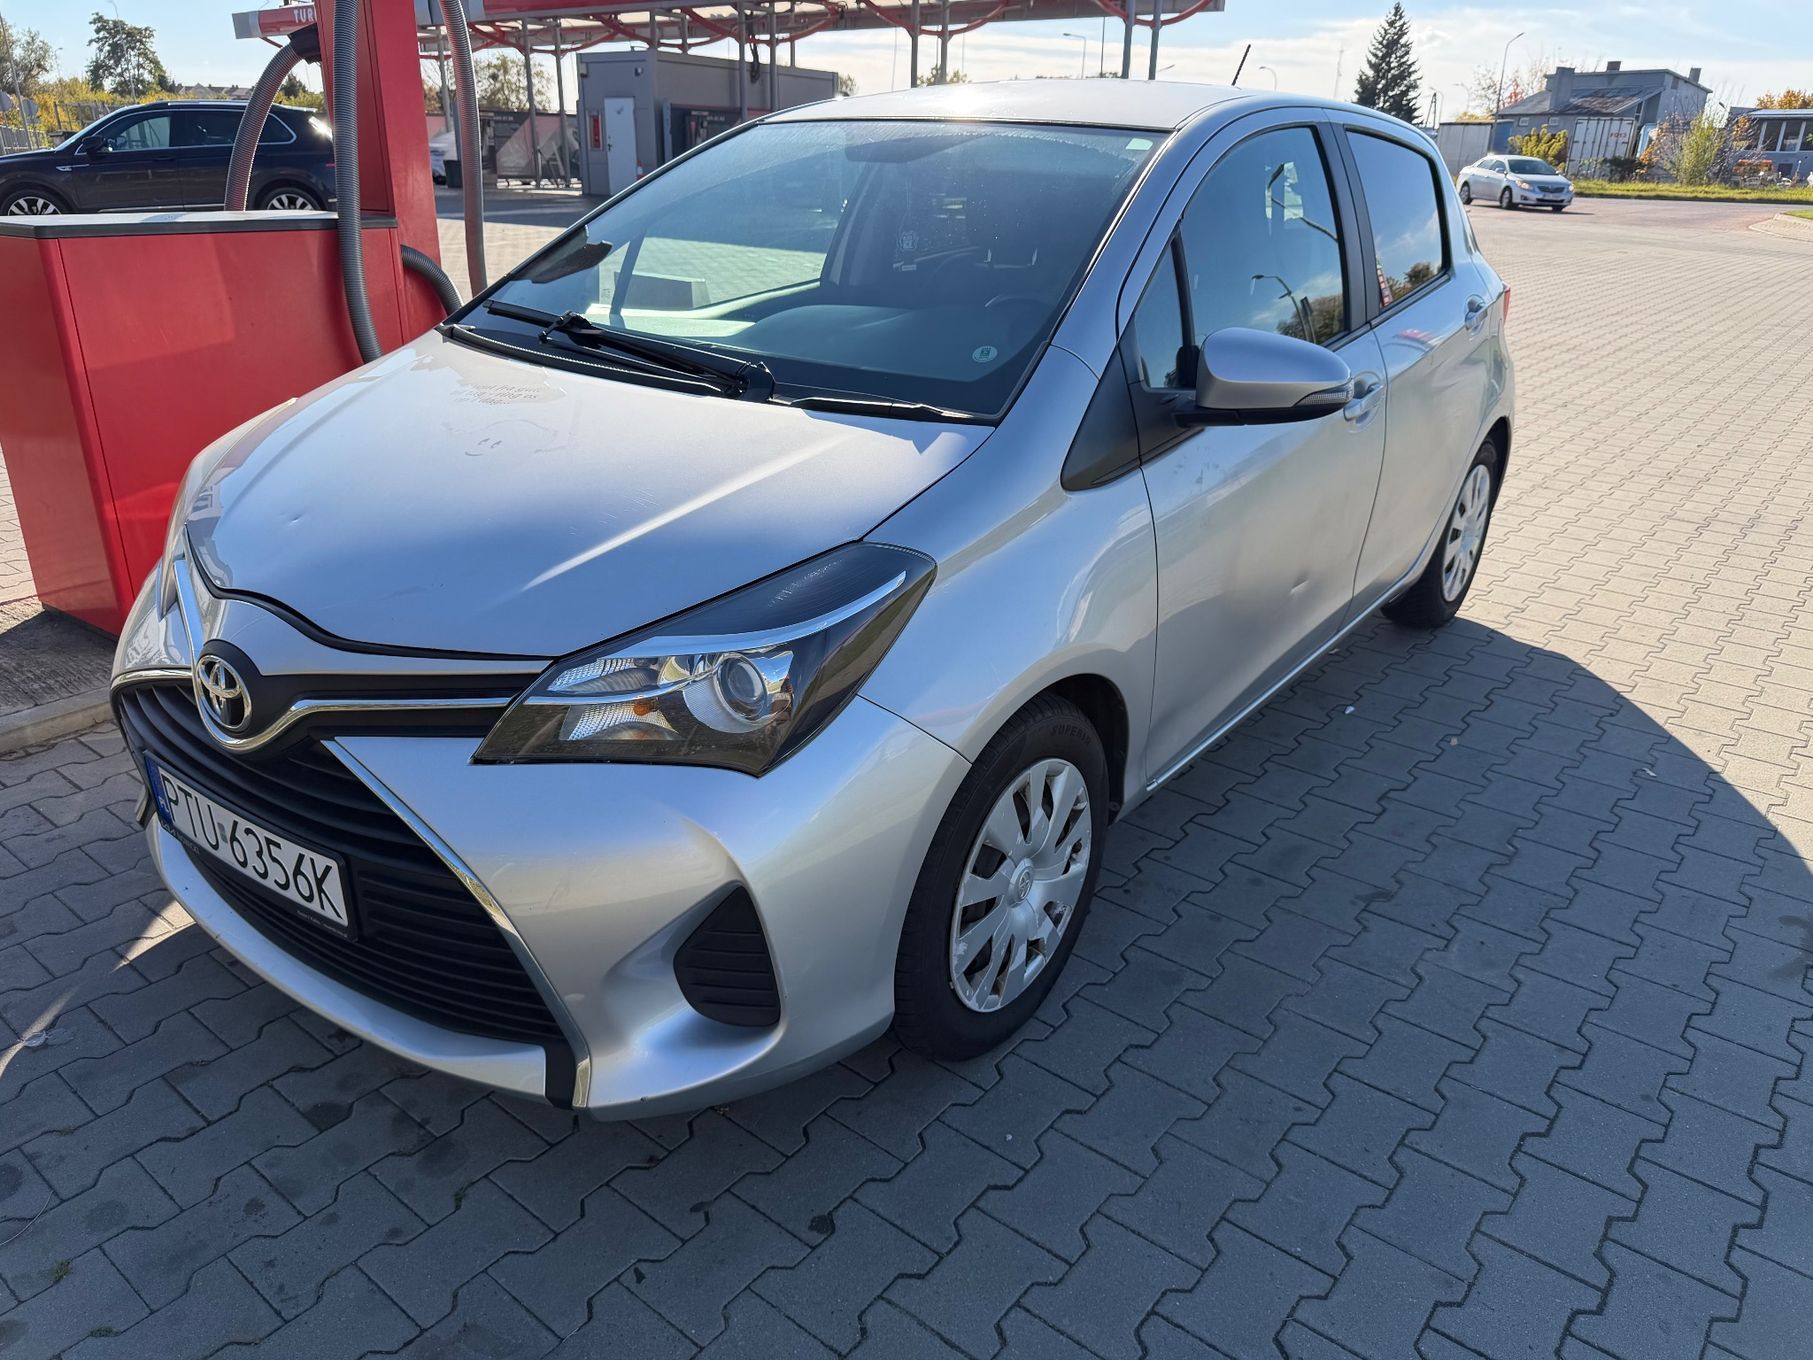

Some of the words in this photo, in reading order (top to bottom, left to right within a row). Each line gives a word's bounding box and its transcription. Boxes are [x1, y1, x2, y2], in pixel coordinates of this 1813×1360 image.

[293, 8, 314, 24] TUR
[158, 796, 170, 814] PL
[161, 774, 220, 851] PTU
[229, 820, 343, 920] 6356K
